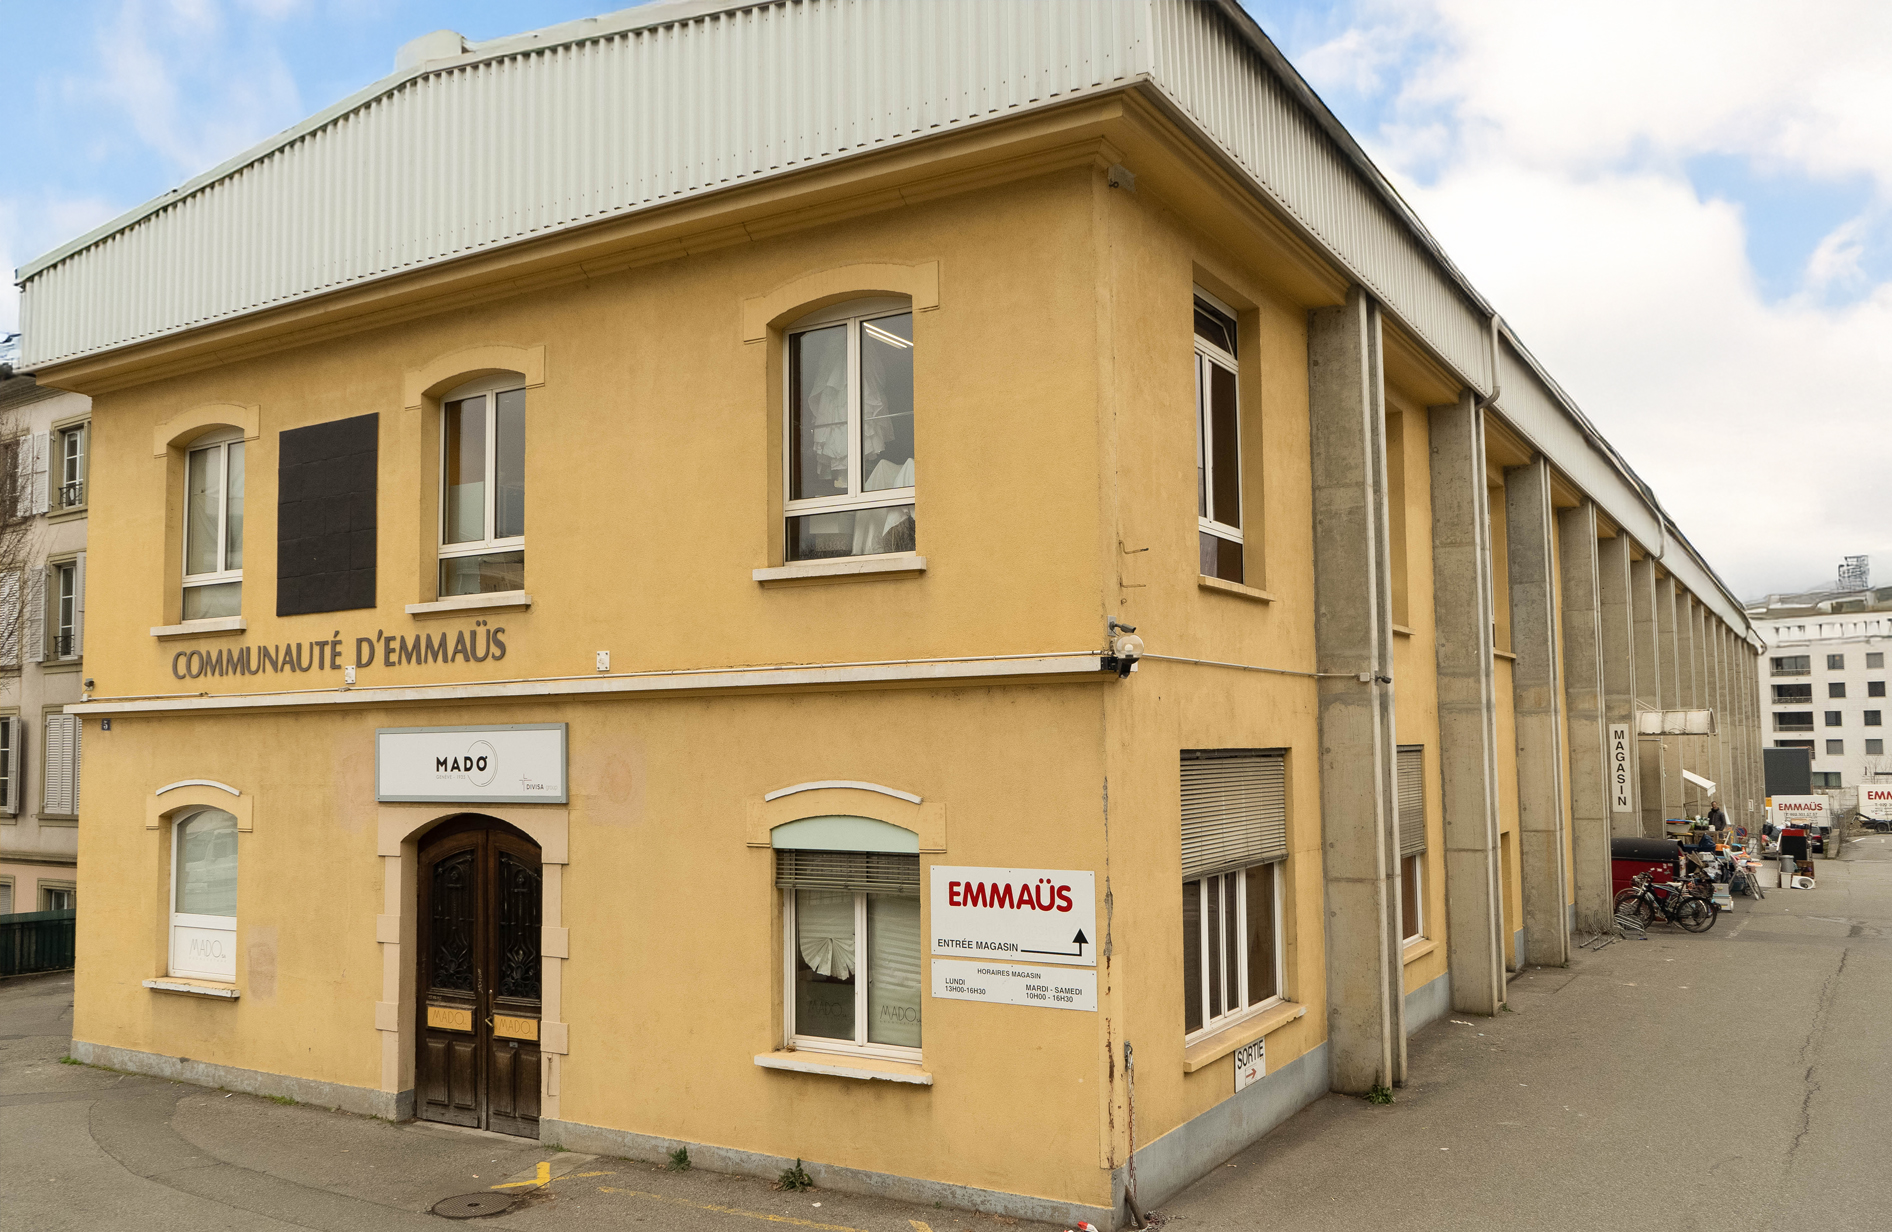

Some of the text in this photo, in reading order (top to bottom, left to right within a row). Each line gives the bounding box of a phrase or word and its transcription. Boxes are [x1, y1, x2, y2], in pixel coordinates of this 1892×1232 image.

[172, 619, 506, 679] COMMUNAUTÉ D'EMMAÜS
[1614, 730, 1627, 806] MAGASIN
[1778, 801, 1823, 811] EMMAÜS
[948, 878, 1073, 912] EMMAÜS
[189, 938, 222, 958] MADO
[937, 938, 1019, 952] ENTRÉE MAGASIN
[945, 977, 966, 985] LUNDI
[977, 968, 1041, 979] HORAIRES MAGASIN
[945, 985, 986, 995] 13H00-16H30
[1025, 984, 1049, 993] MARDI
[1054, 986, 1082, 996] SAMEDI
[1025, 992, 1046, 1001] 10H00
[1052, 994, 1073, 1003] 16H30
[808, 999, 842, 1017] MADO
[880, 1005, 917, 1022] MADO
[432, 1009, 465, 1025] MADO
[499, 1018, 531, 1035] MADO
[1237, 1039, 1264, 1070] SORTIE
